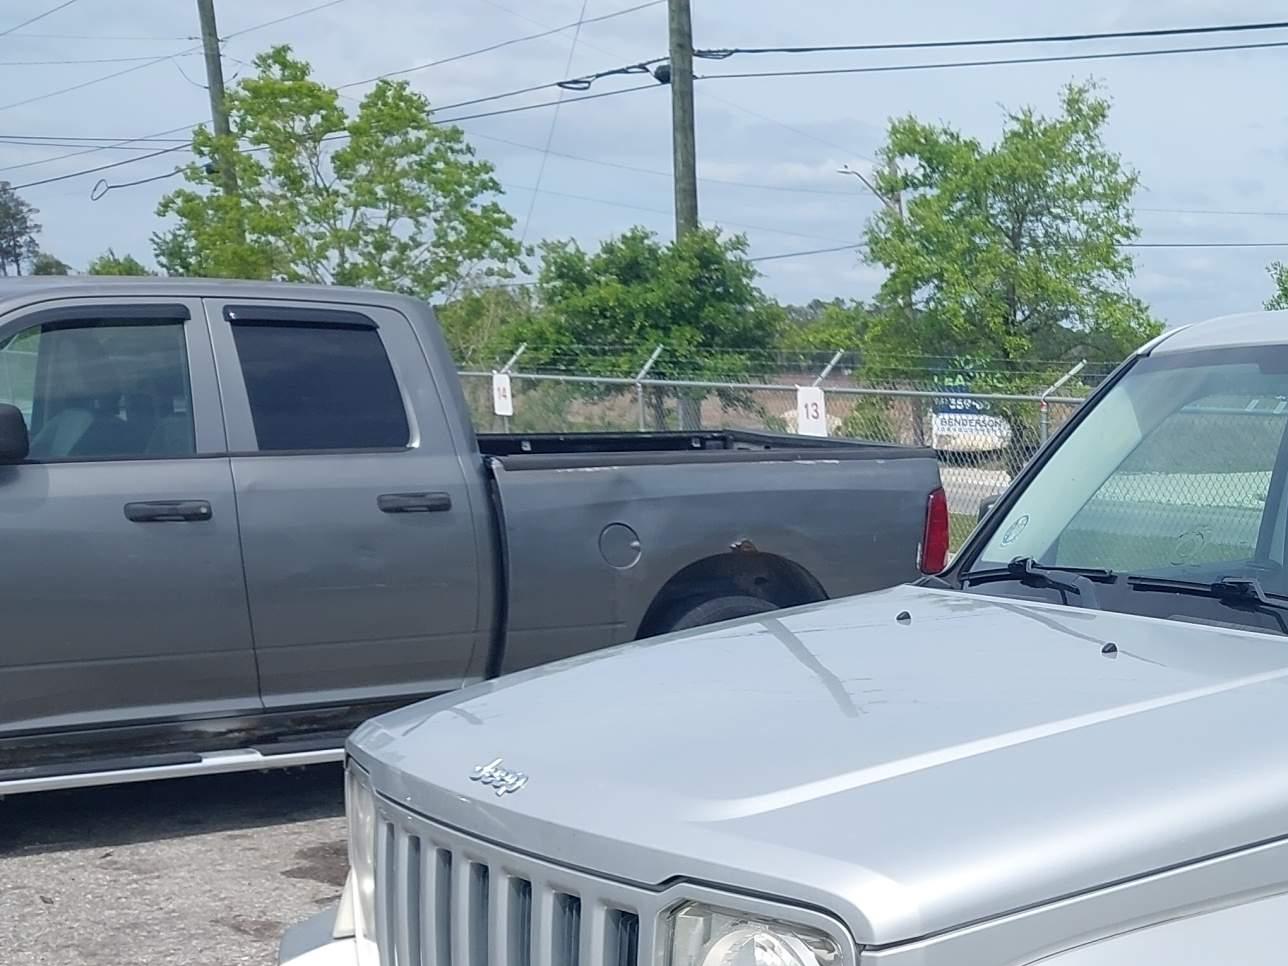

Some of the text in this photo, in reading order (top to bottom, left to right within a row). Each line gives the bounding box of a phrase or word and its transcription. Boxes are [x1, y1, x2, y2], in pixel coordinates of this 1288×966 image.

[497, 386, 507, 400] 14
[804, 402, 820, 420] 13
[940, 419, 1002, 428] BENDERSON
[469, 757, 529, 798] Jeep
